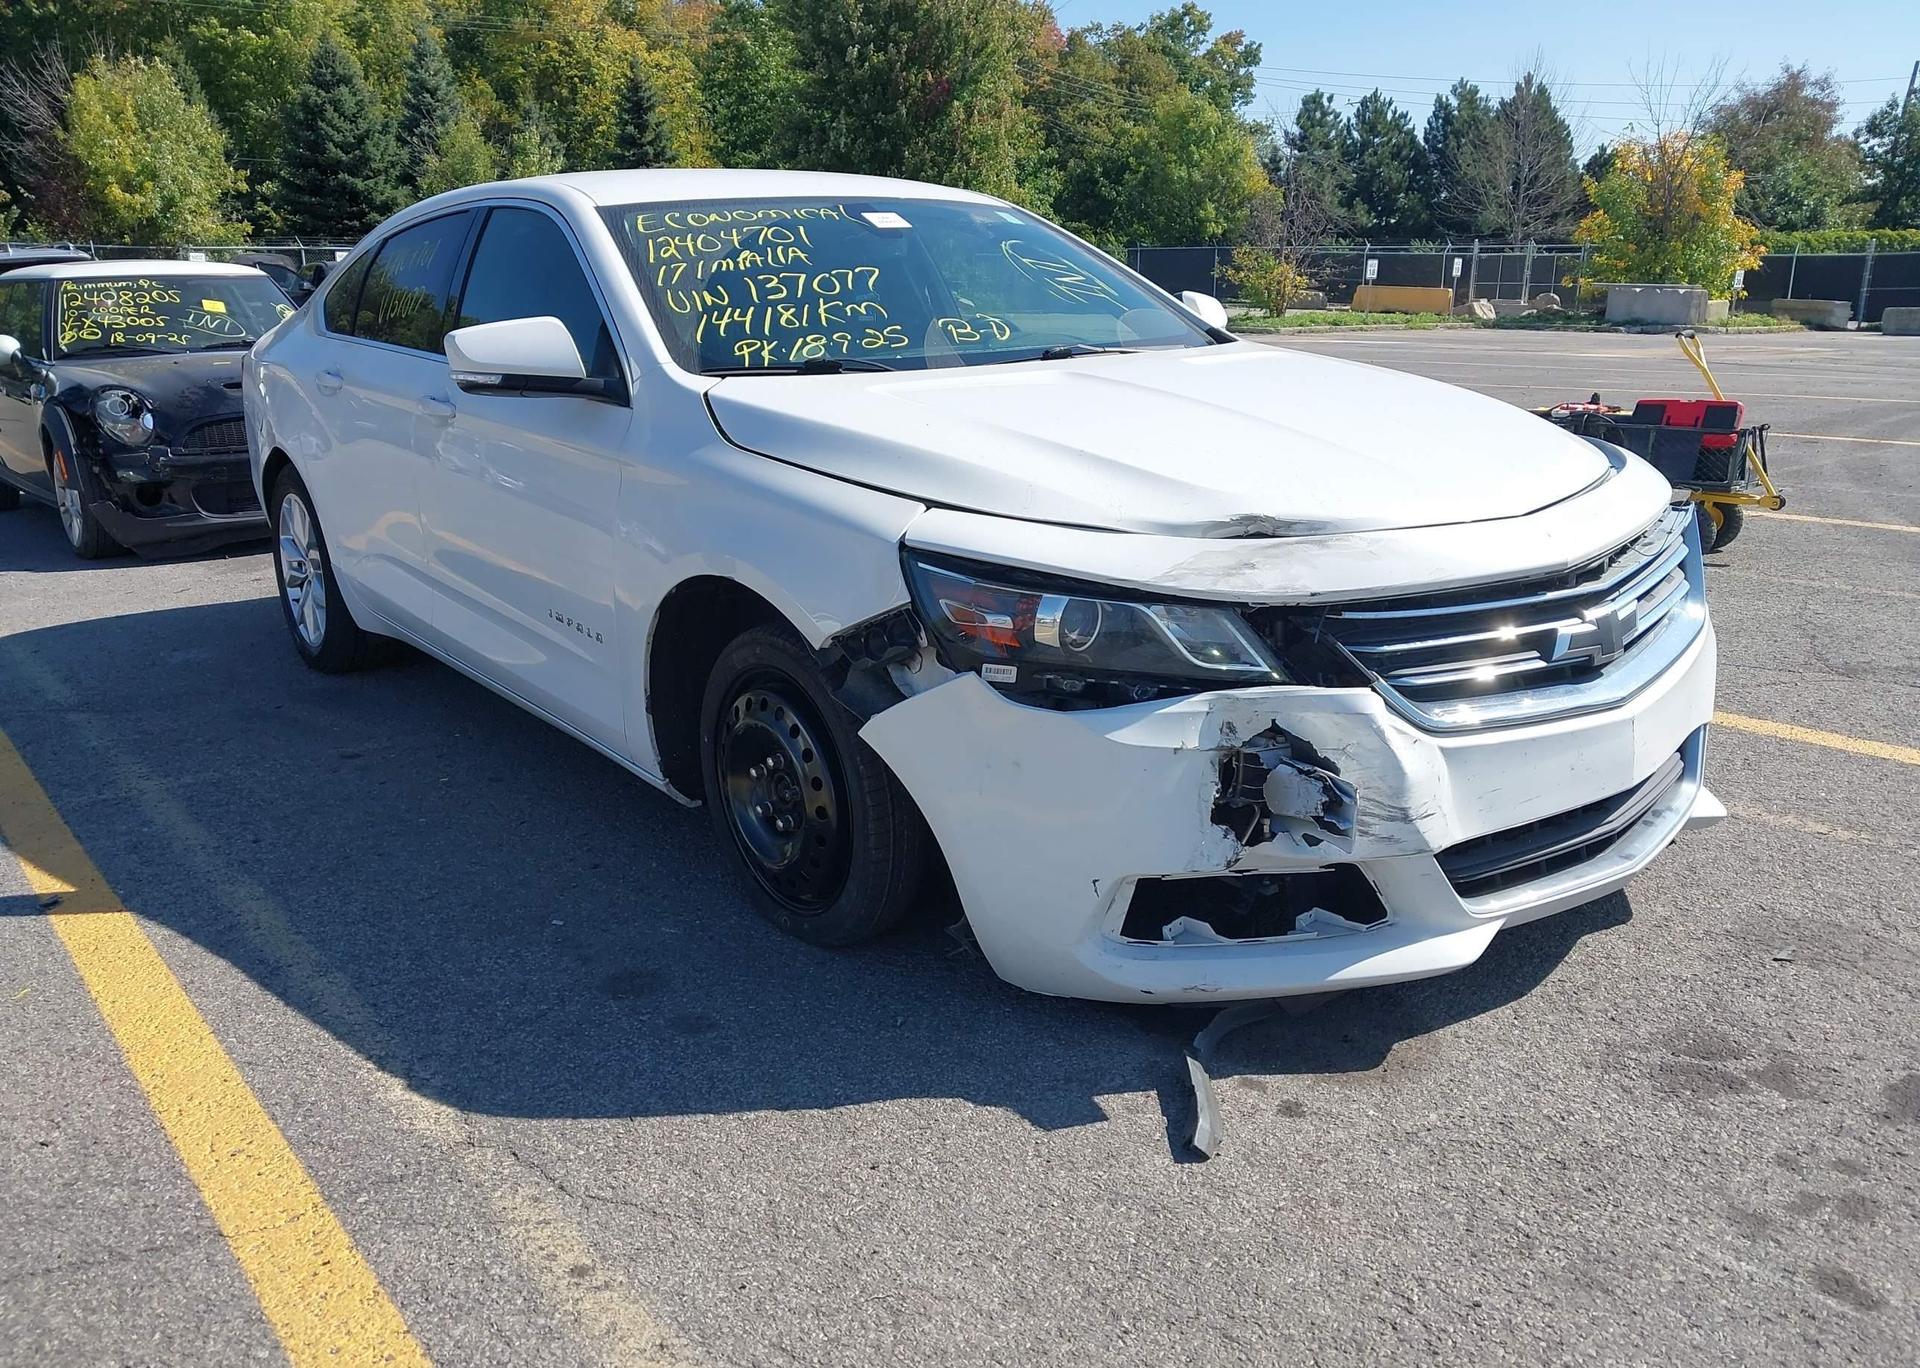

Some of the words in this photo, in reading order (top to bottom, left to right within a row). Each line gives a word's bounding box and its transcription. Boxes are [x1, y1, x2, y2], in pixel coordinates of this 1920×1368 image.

[649, 226, 813, 263] 12404701
[63, 290, 182, 309] 12408205
[744, 267, 880, 303] 137077
